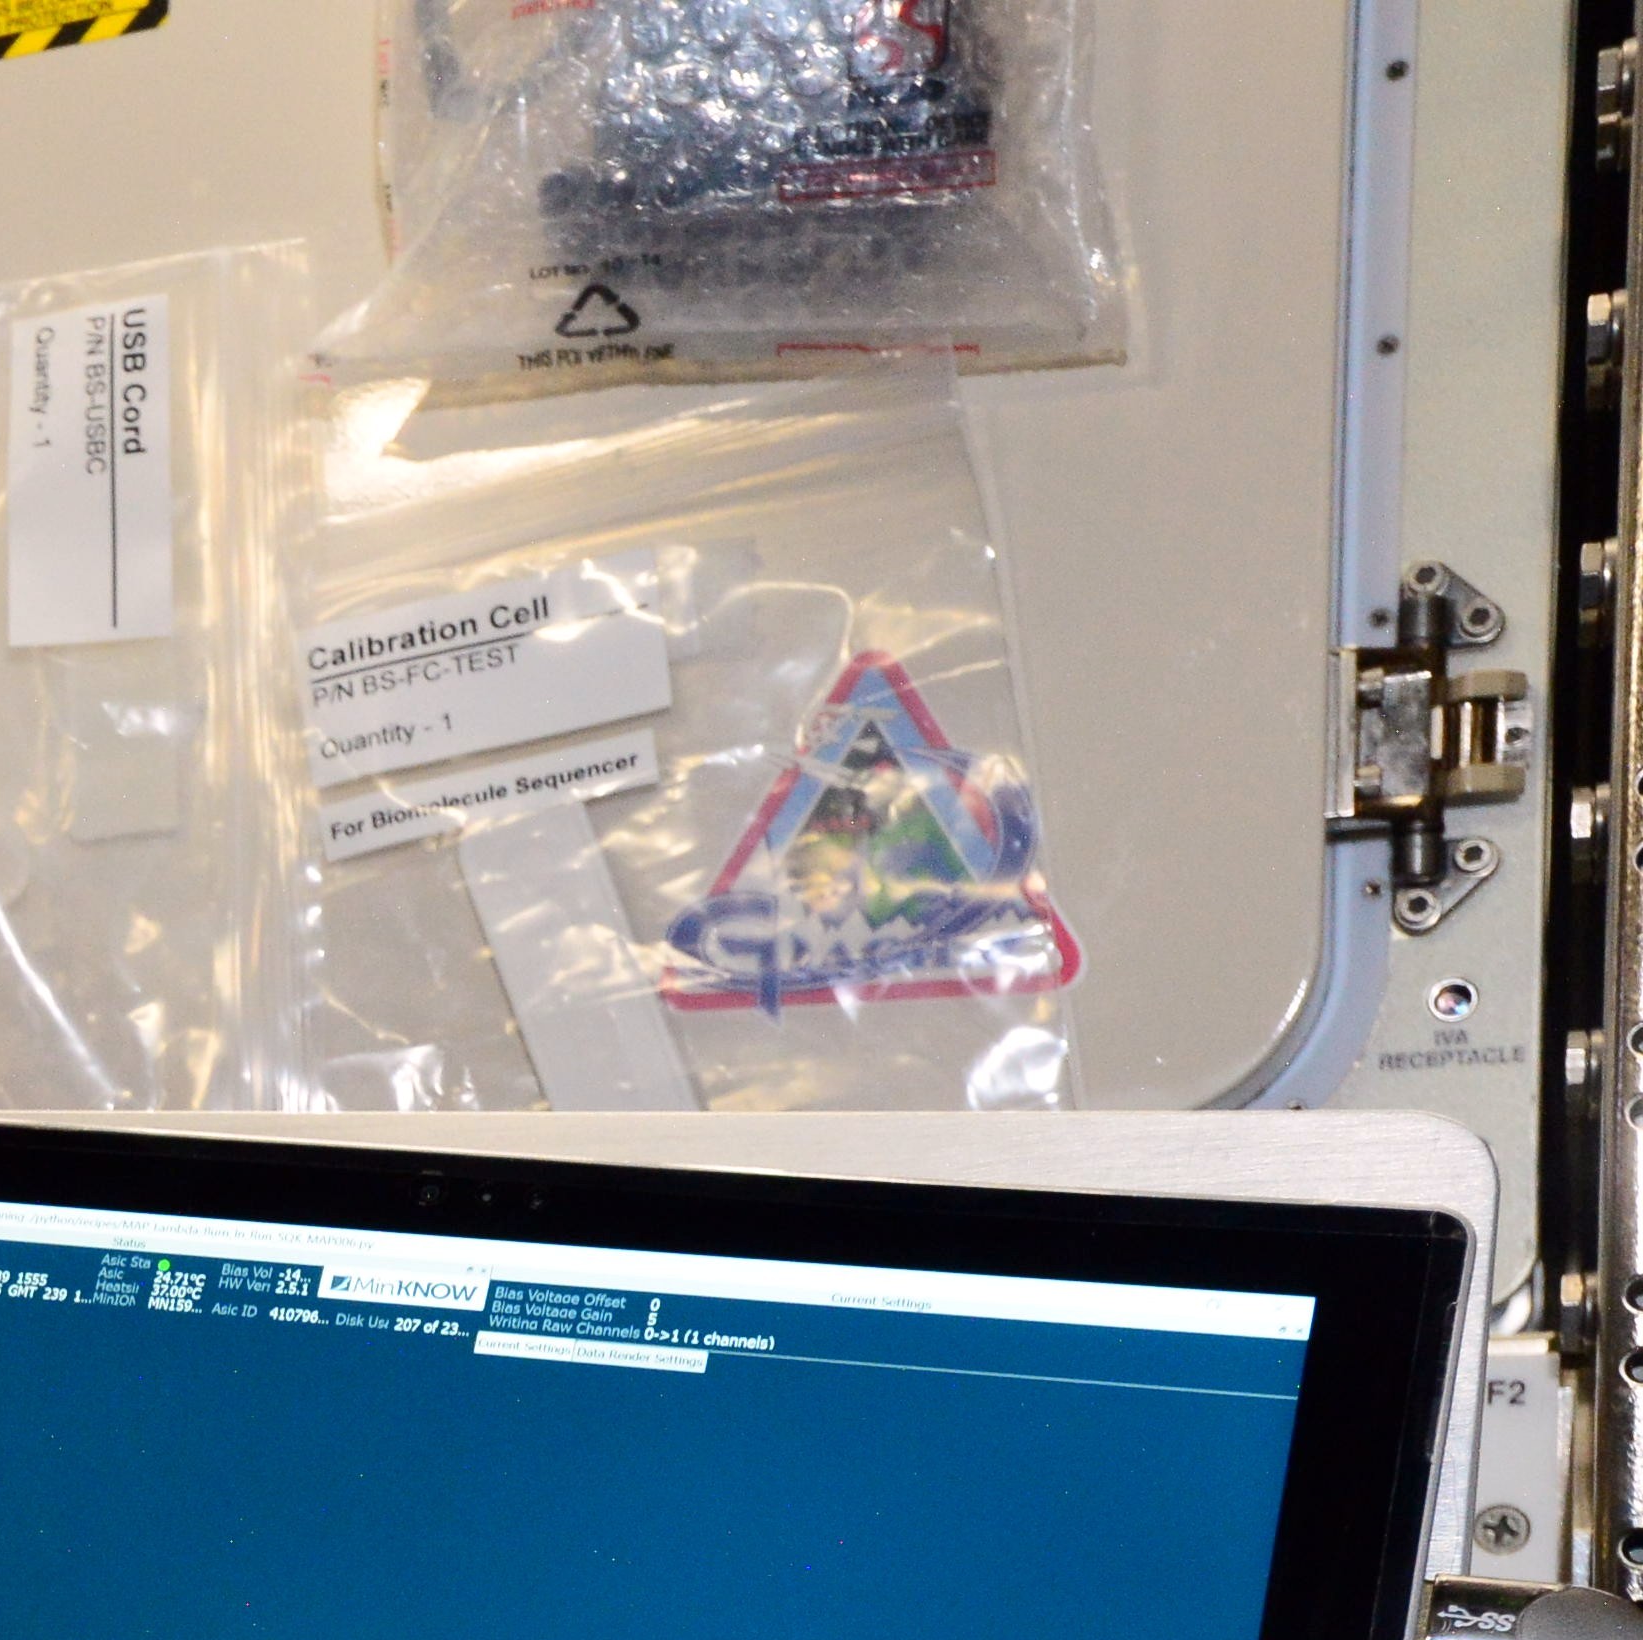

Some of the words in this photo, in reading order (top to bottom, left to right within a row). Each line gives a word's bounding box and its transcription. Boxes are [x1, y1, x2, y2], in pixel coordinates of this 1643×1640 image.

[29, 327, 55, 414] Quantity
[123, 308, 146, 373] USB
[85, 363, 107, 475] BS-USBC
[123, 383, 147, 455] Cord
[307, 614, 478, 671] Calibration
[489, 595, 550, 630] Cell
[313, 682, 355, 708] P/N
[363, 643, 520, 696] BS-FC-TEST
[319, 725, 416, 761] Quantity
[443, 712, 453, 731] 1
[330, 818, 364, 841] For
[514, 752, 640, 795] Sequencer
[1379, 1045, 1526, 1070] RECEPTACLE
[1434, 1028, 1468, 1046] IVA
[16, 1271, 49, 1287] 1555
[353, 1277, 479, 1302] MinKNOW
[494, 1286, 524, 1301] Bias
[528, 1289, 581, 1306] Voltage
[583, 1293, 627, 1310] Offset
[649, 1297, 661, 1313] 0
